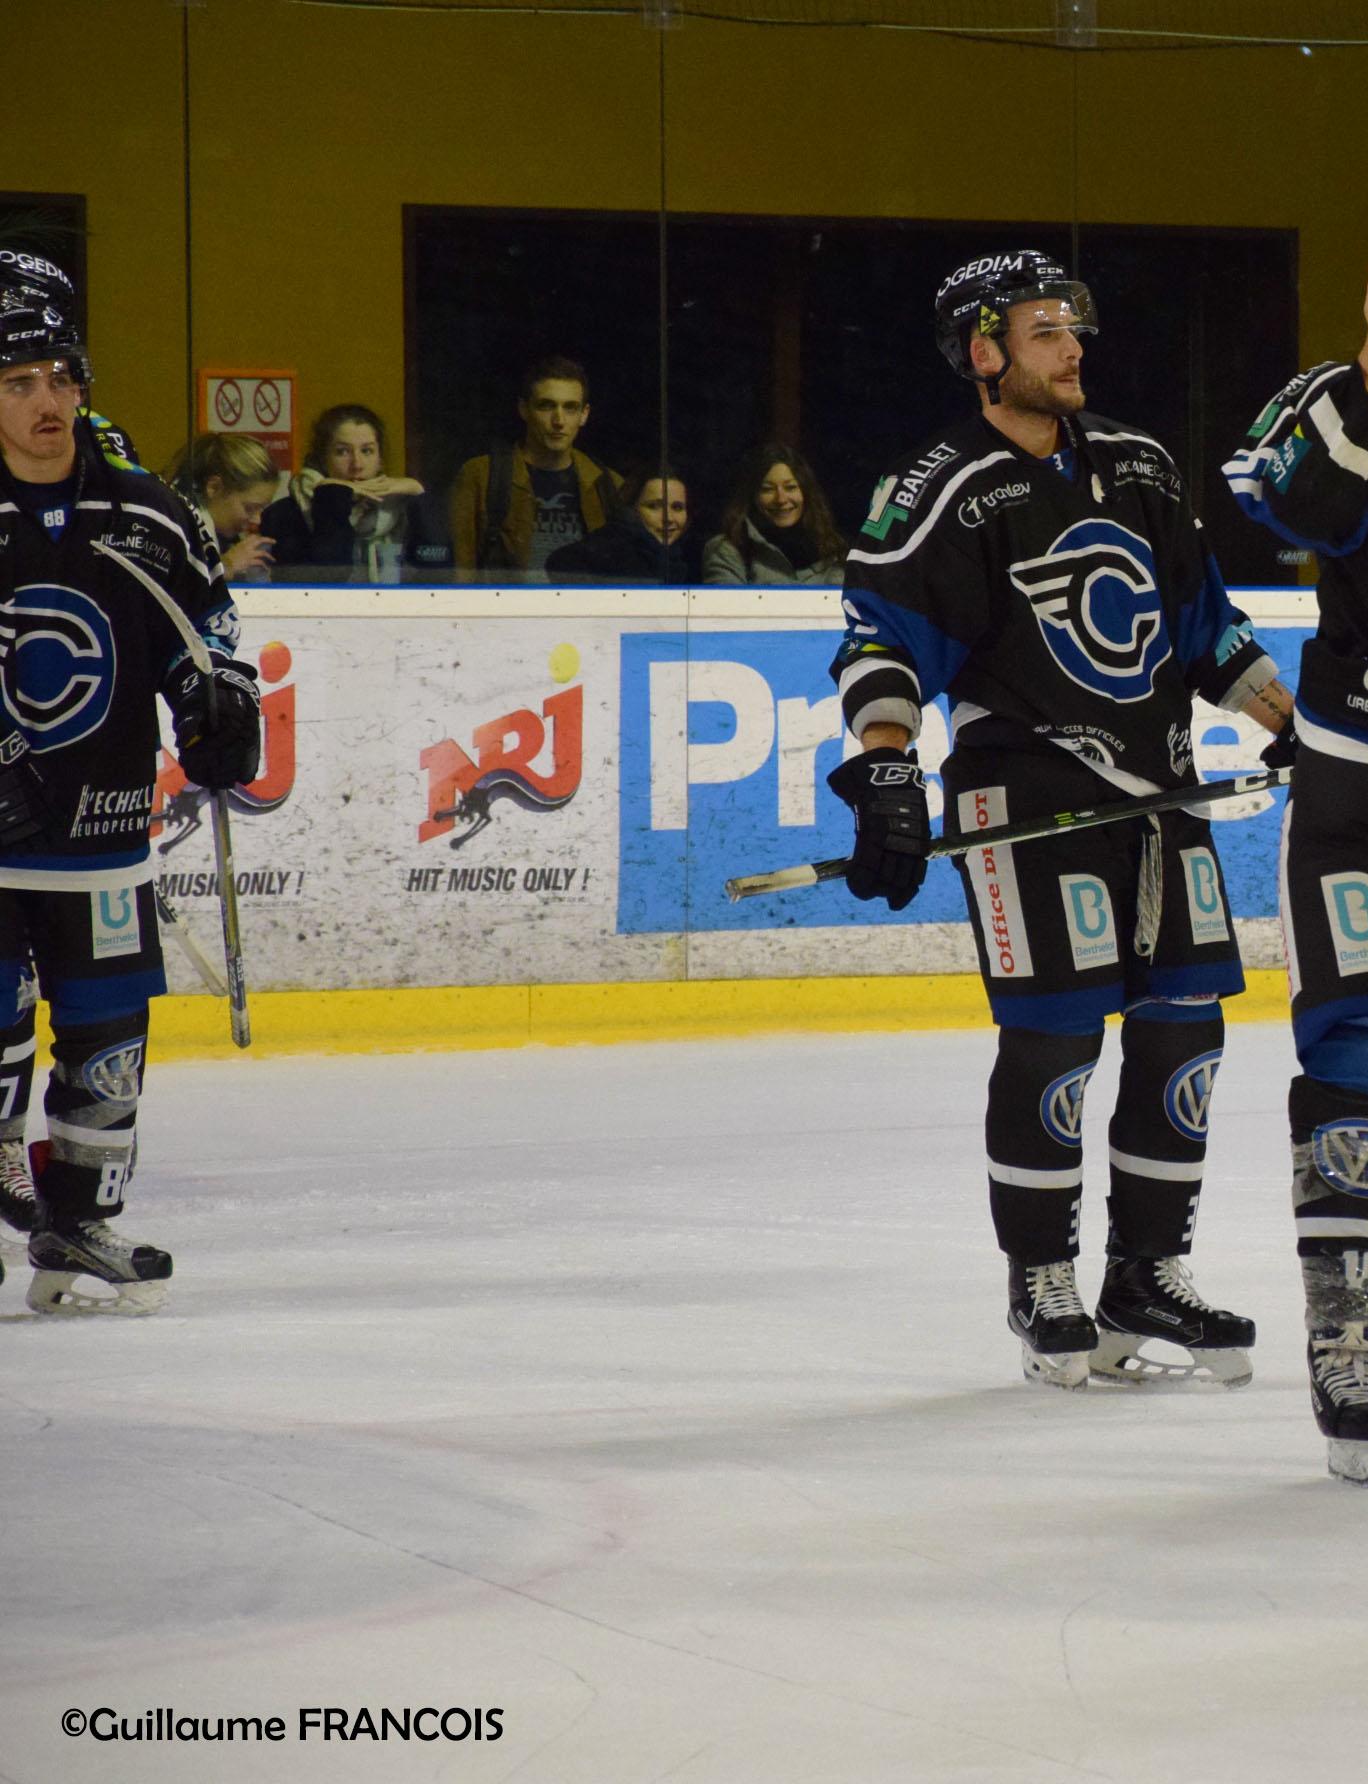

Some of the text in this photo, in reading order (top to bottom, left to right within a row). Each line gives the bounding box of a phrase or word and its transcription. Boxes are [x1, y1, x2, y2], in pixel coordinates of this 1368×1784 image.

[953, 299, 981, 317] CCM
[7, 329, 46, 341] CCM
[894, 441, 958, 509] BALLET
[43, 509, 65, 528] 88
[236, 872, 291, 897] ONLY
[407, 867, 591, 893] HIT MUSIC ONLY !
[975, 792, 1016, 975] Office DEOT
